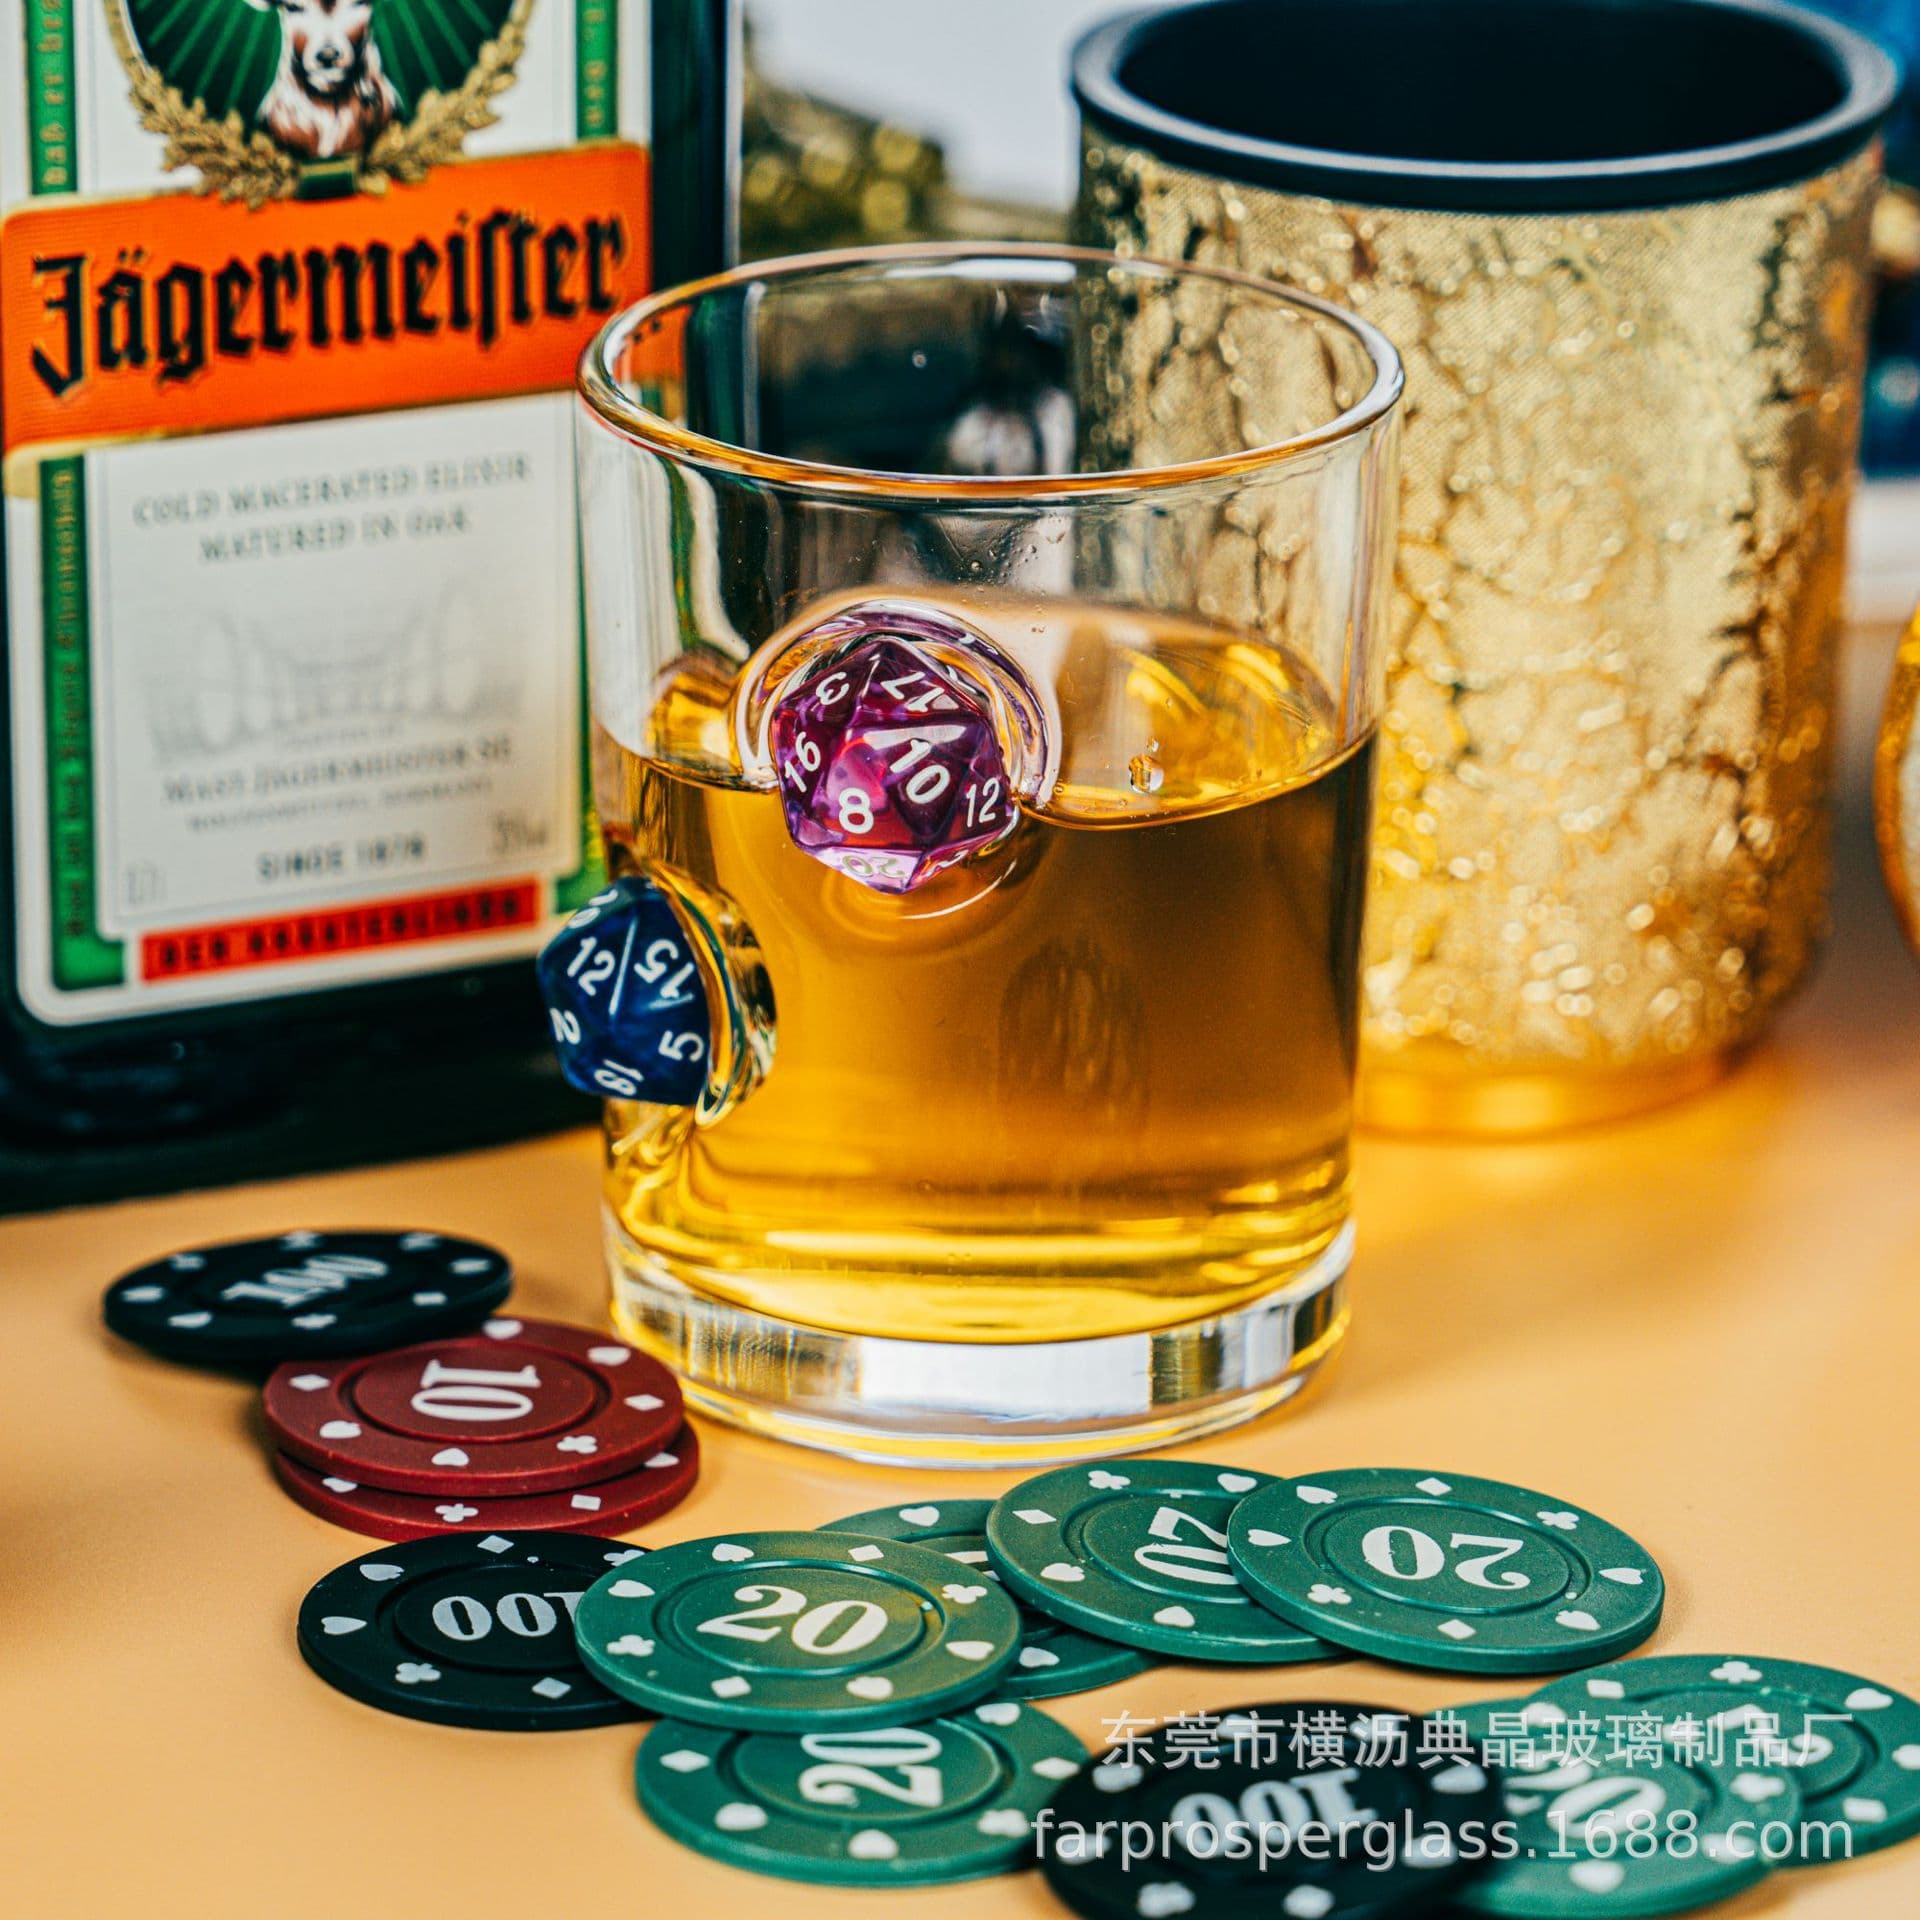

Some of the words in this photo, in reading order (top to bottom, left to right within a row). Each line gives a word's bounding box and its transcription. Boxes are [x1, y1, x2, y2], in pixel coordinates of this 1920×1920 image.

[816, 672, 849, 705] 3
[881, 671, 944, 712] 17
[785, 732, 820, 792] 16
[890, 739, 950, 804] 10
[839, 788, 874, 834] 8
[966, 778, 1000, 827] 12
[567, 937, 615, 996] 12
[634, 939, 694, 999] 15
[551, 1008, 581, 1045] 2
[658, 1031, 704, 1062] 5
[411, 1359, 541, 1421] 10
[1361, 1525, 1531, 1591] 20
[696, 1585, 888, 1655] 20
[799, 1727, 943, 1808] 20
